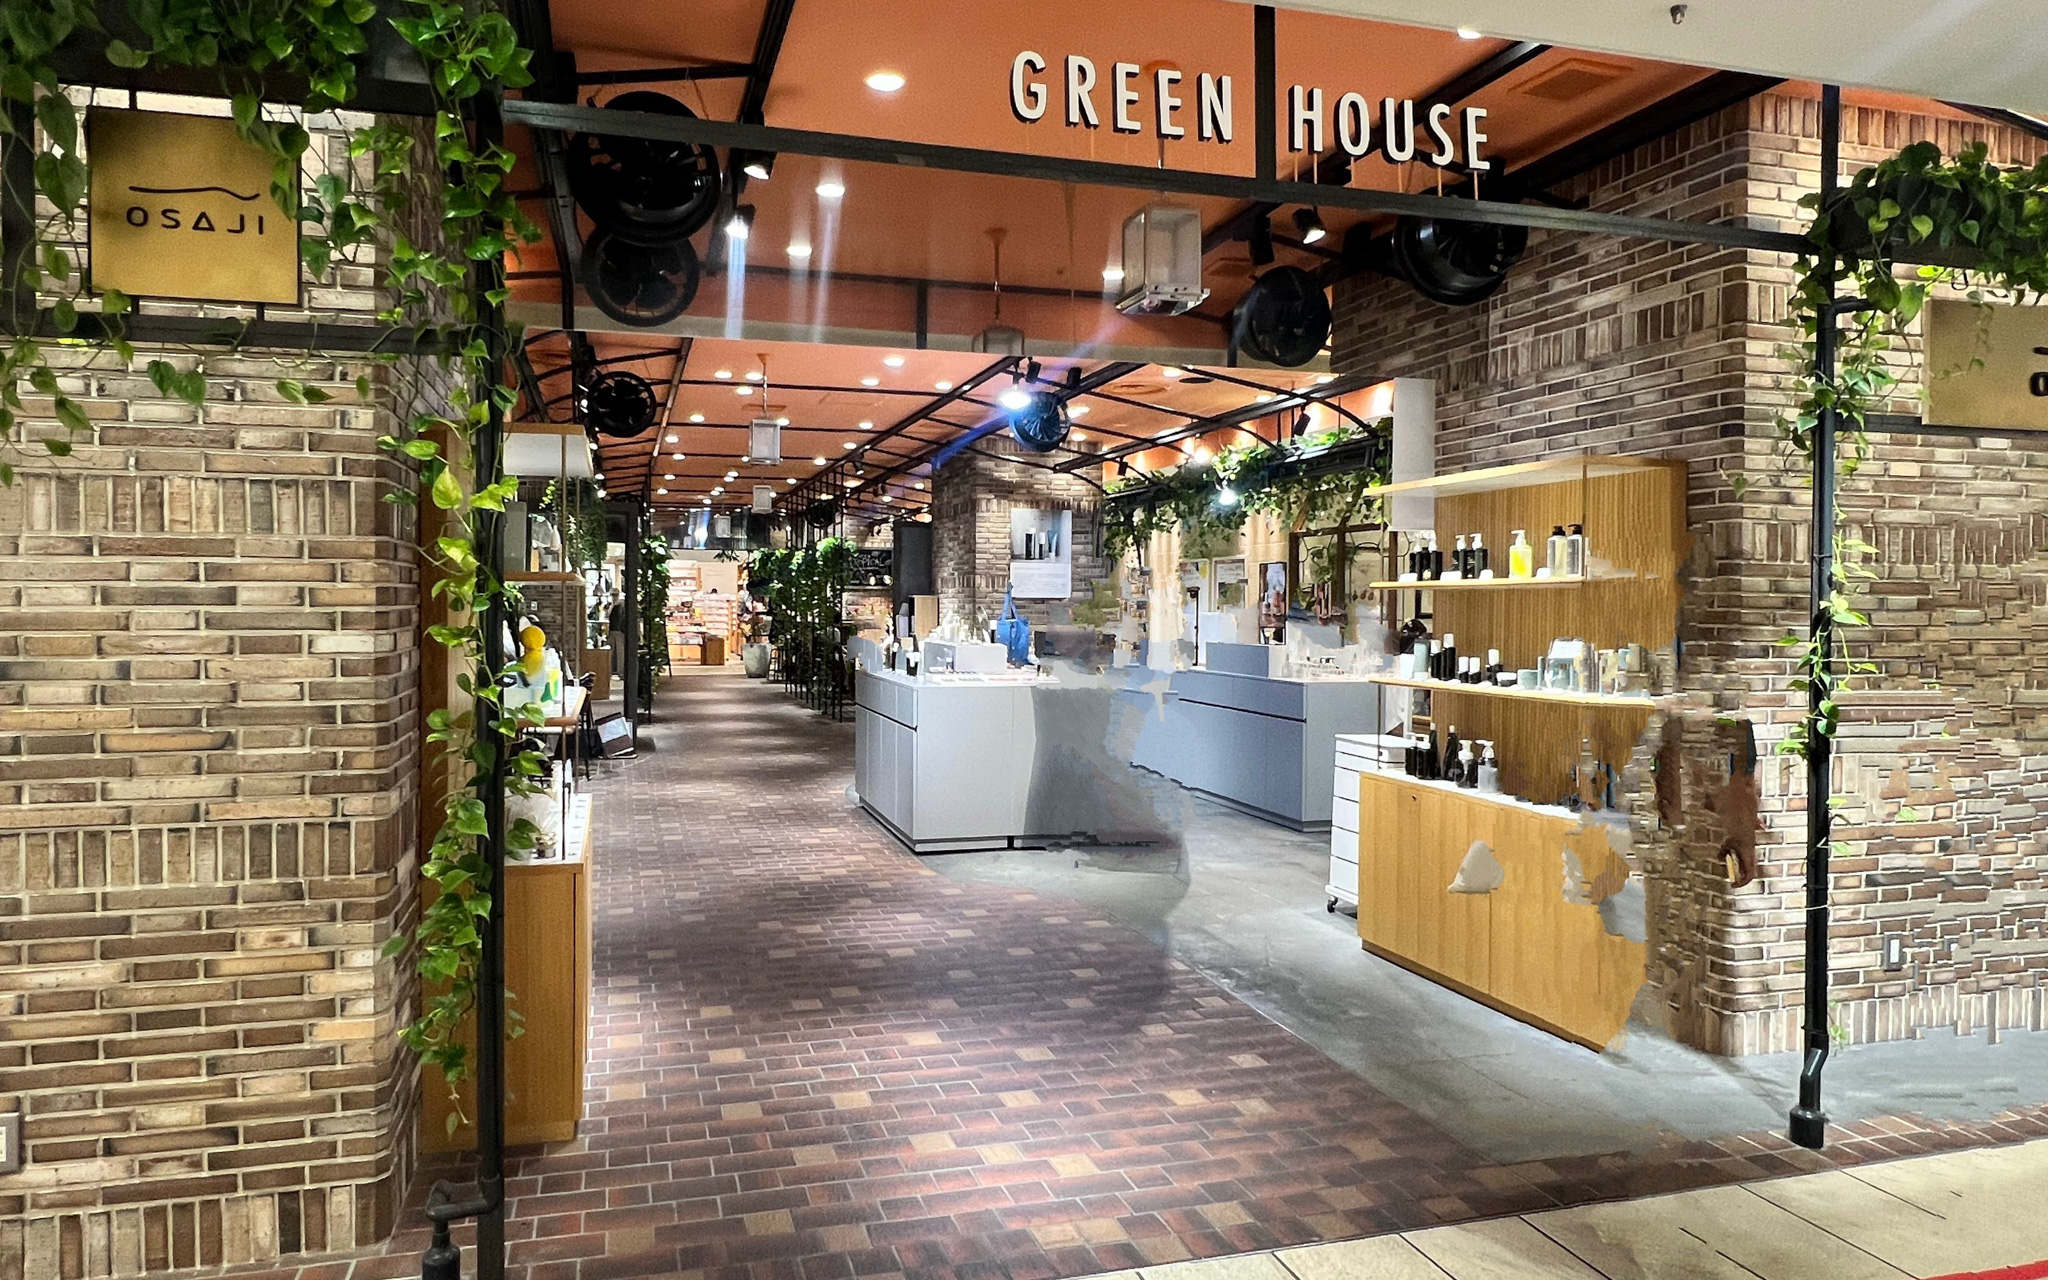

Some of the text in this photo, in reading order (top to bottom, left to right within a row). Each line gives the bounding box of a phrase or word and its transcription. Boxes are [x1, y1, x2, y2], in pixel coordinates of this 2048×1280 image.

[1011, 50, 1491, 171] GREEN HOUSE
[126, 206, 264, 235] OSAJI
